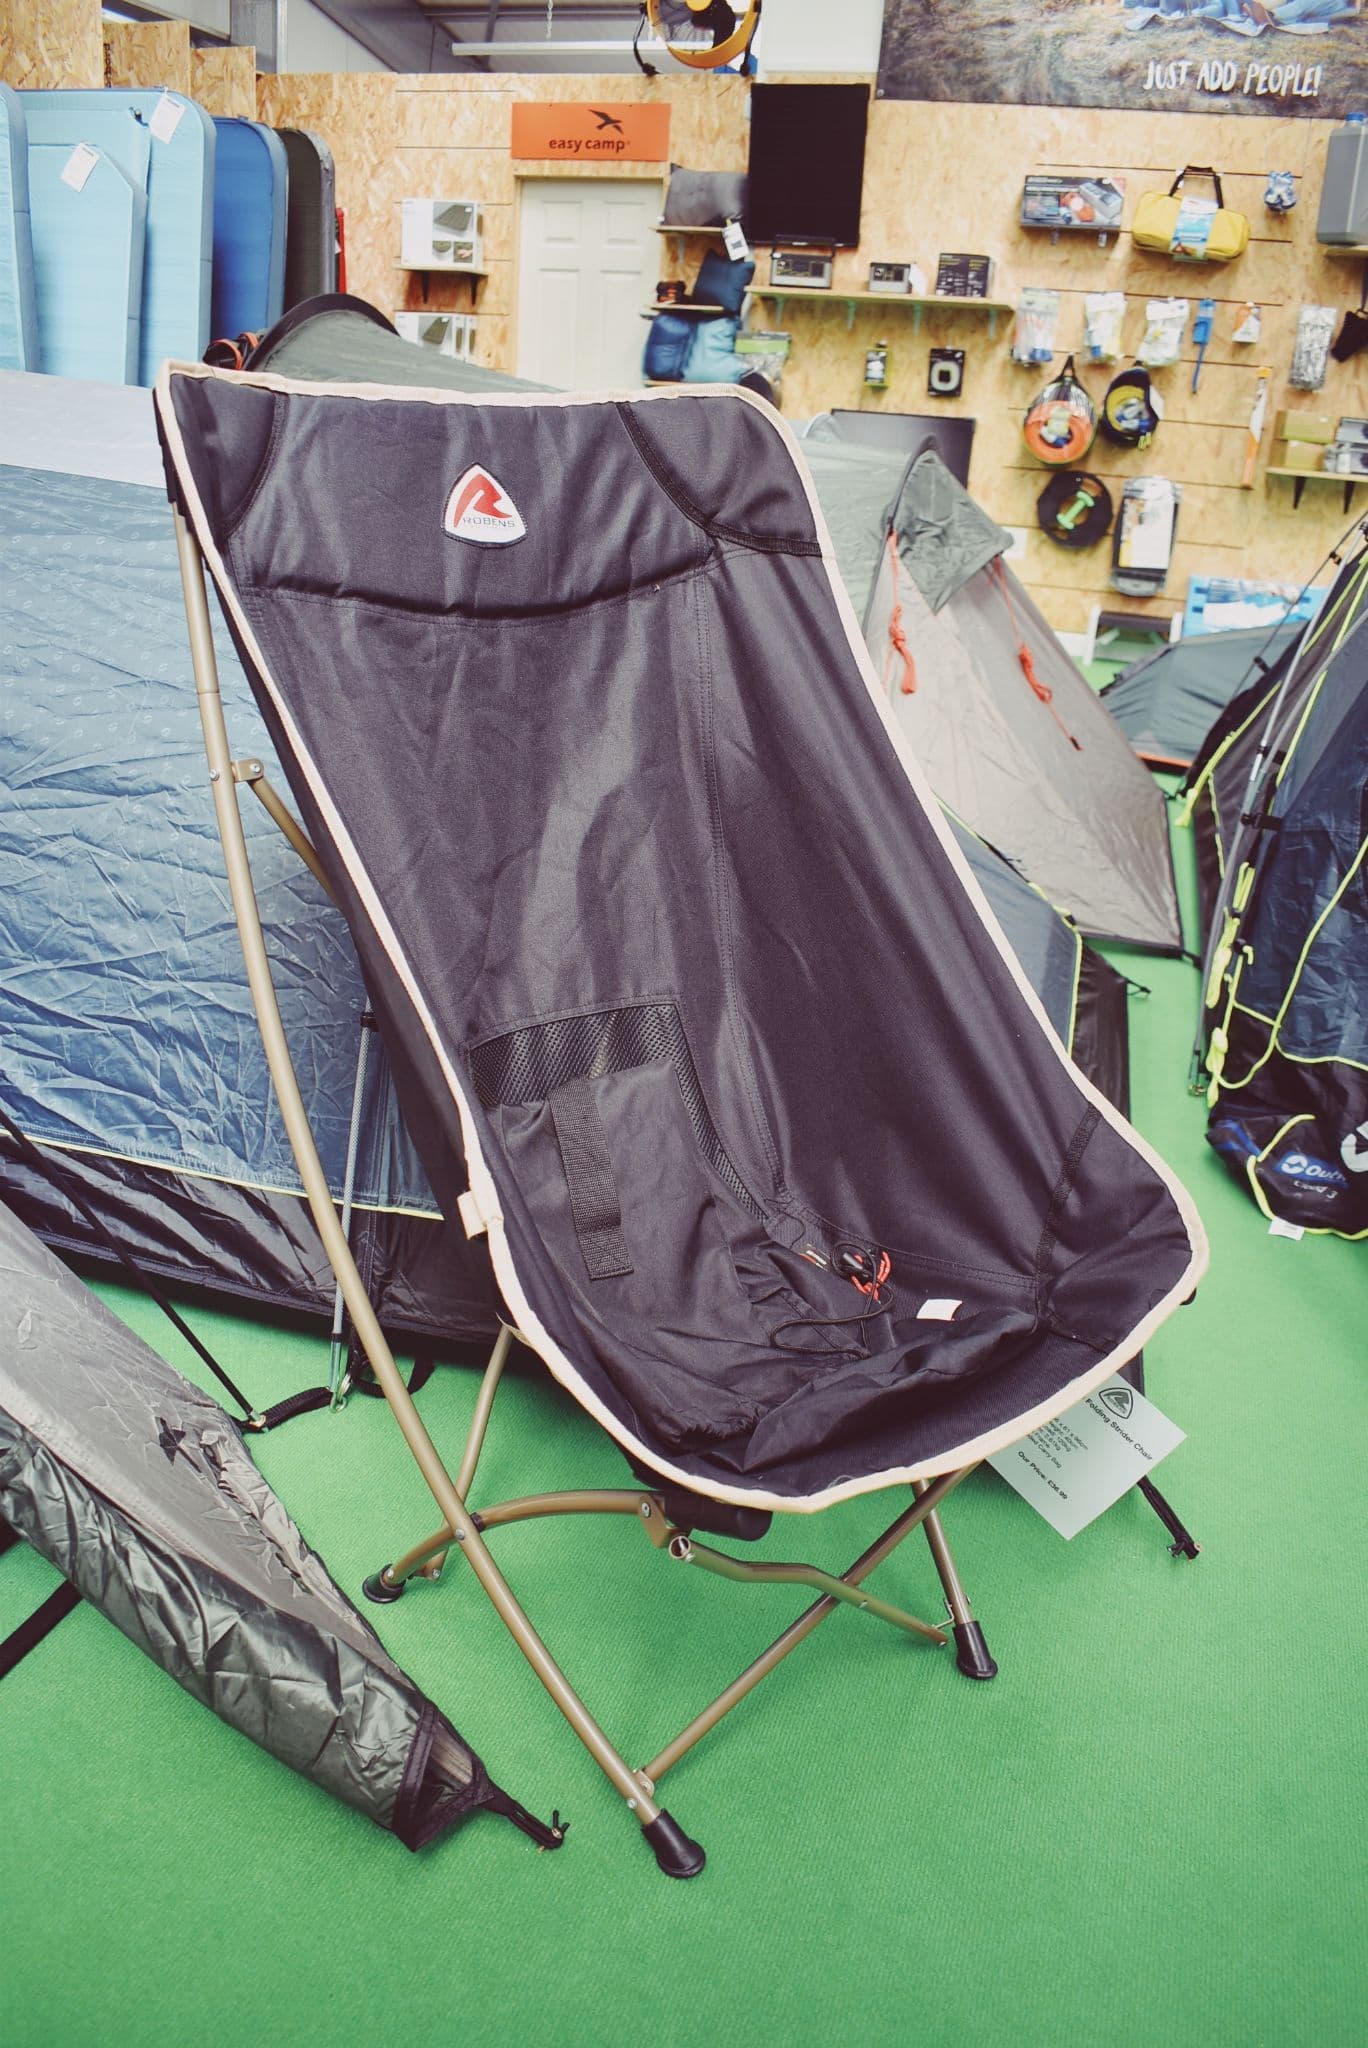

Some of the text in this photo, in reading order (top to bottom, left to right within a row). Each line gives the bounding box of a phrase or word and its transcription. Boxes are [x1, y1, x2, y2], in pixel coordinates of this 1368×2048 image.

[1143, 60, 1322, 97] JUST ADD PEOPLE!
[549, 139, 625, 153] easy camp
[462, 516, 516, 528] ROBENS
[1326, 1190, 1338, 1199] 3
[1085, 1398, 1111, 1423] Folding
[1110, 1421, 1134, 1443] Strider
[1134, 1442, 1153, 1460] Chair
[1018, 1451, 1031, 1463] Our
